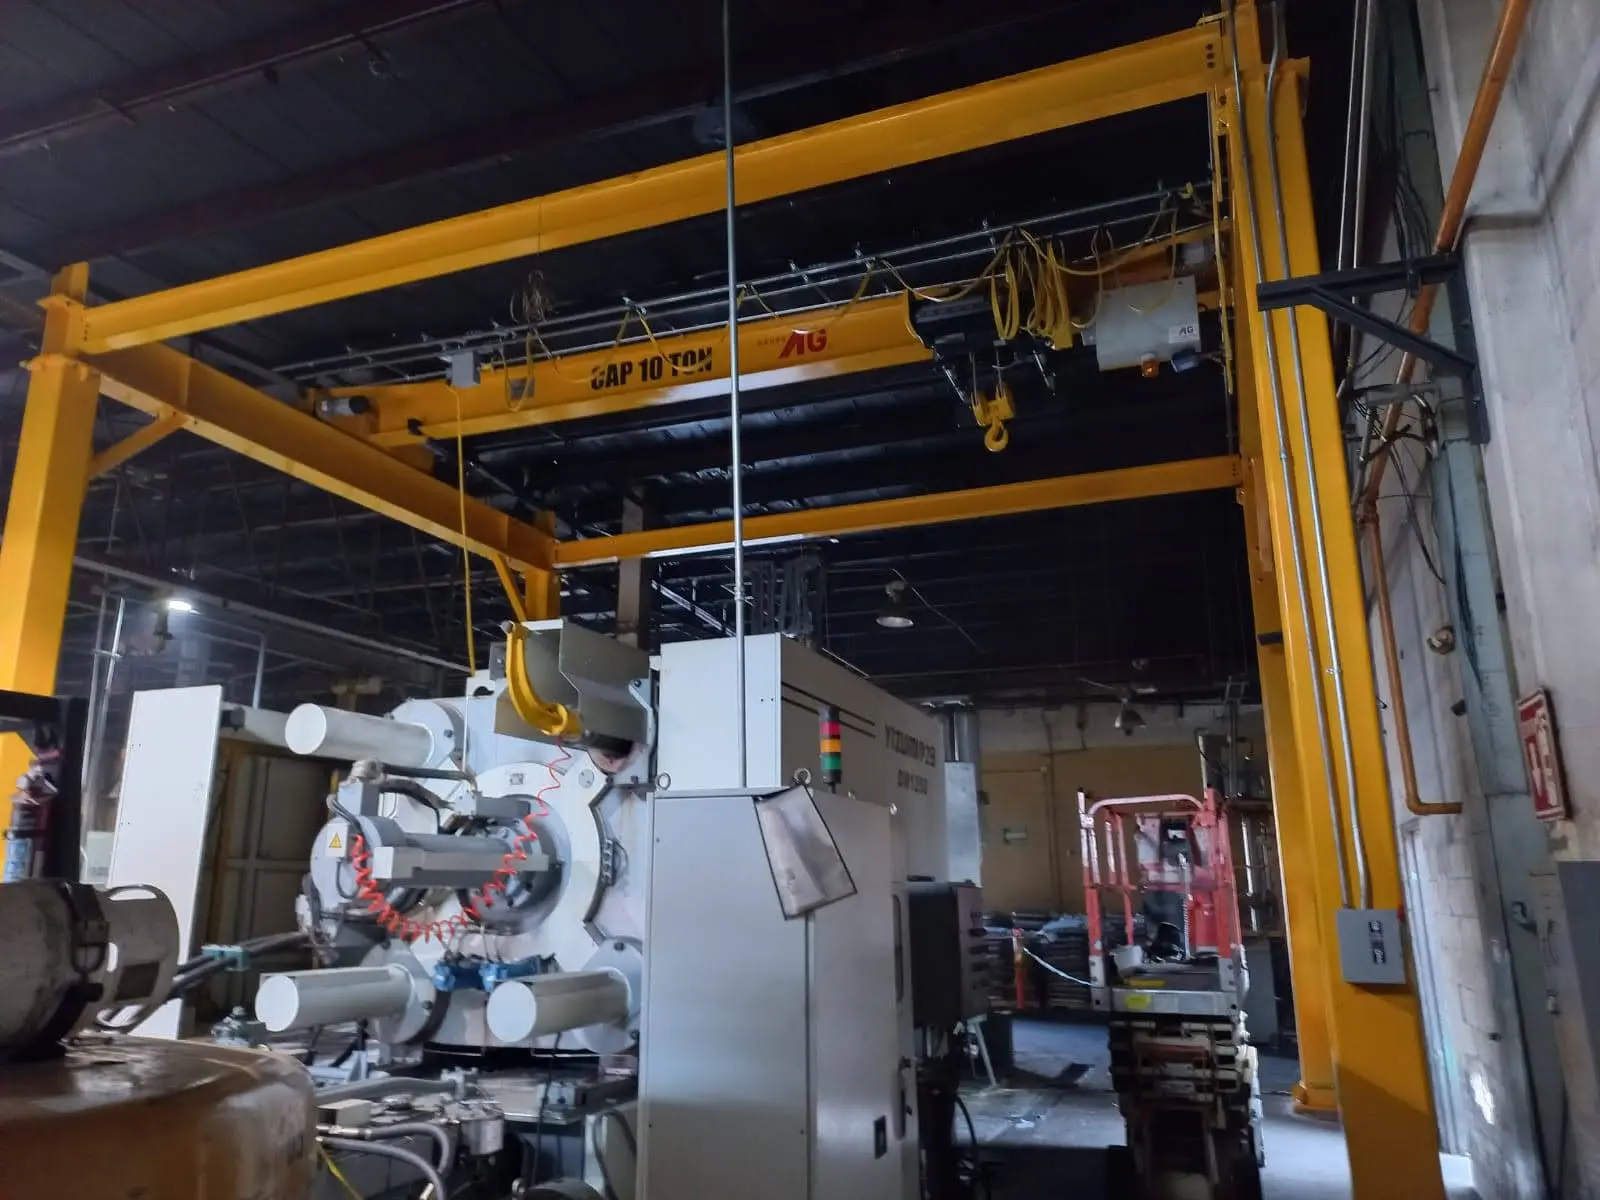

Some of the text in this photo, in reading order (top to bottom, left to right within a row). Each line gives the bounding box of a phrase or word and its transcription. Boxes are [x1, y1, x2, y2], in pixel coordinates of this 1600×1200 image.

[778, 329, 828, 359] AG
[591, 347, 713, 390] CAP 10 TON
